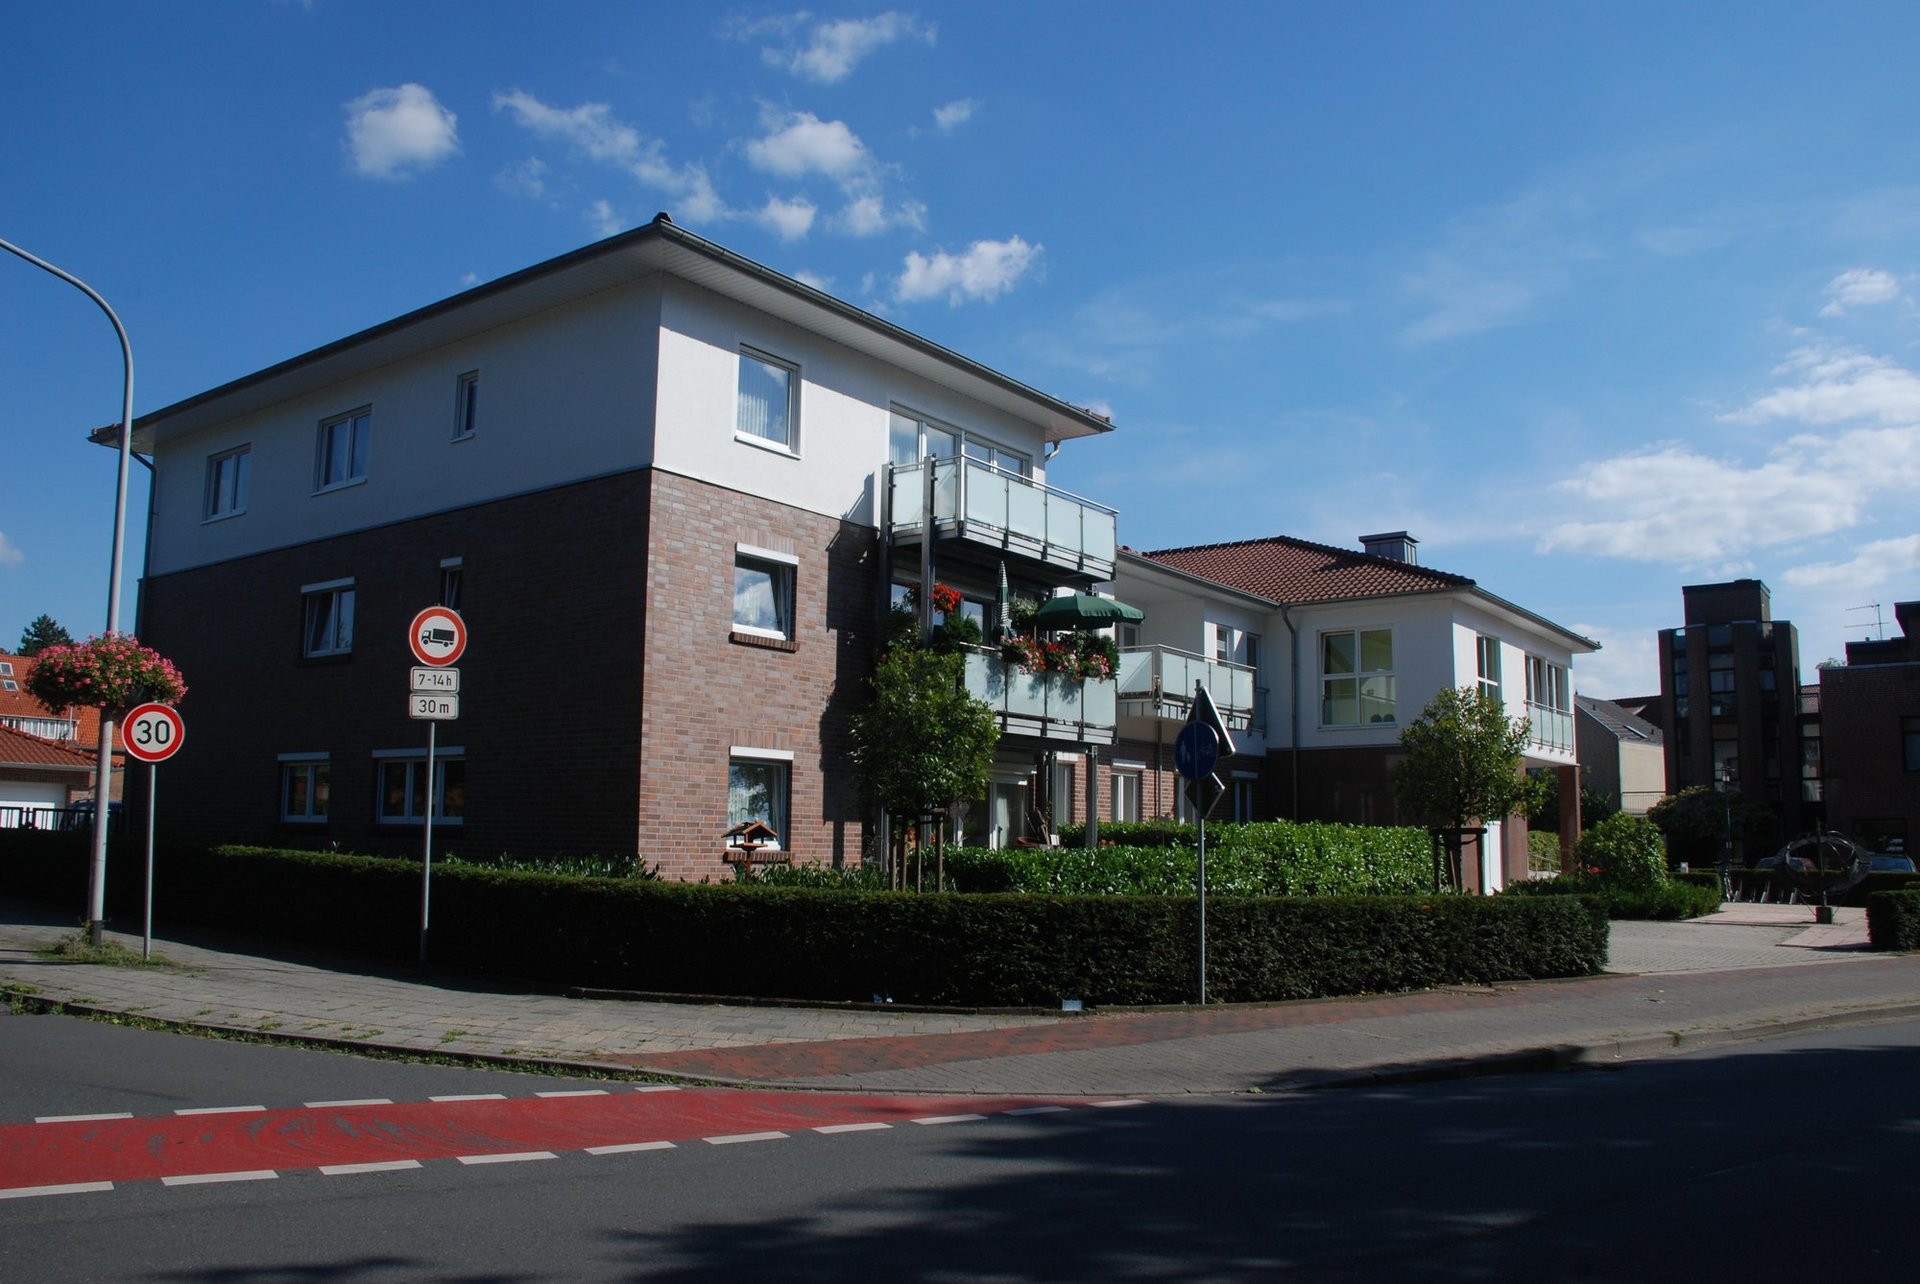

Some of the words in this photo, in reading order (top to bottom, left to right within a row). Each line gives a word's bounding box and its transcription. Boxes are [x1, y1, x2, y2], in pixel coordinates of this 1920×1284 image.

[419, 699, 436, 713] 30
[439, 703, 449, 713] m
[136, 719, 170, 744] 30
